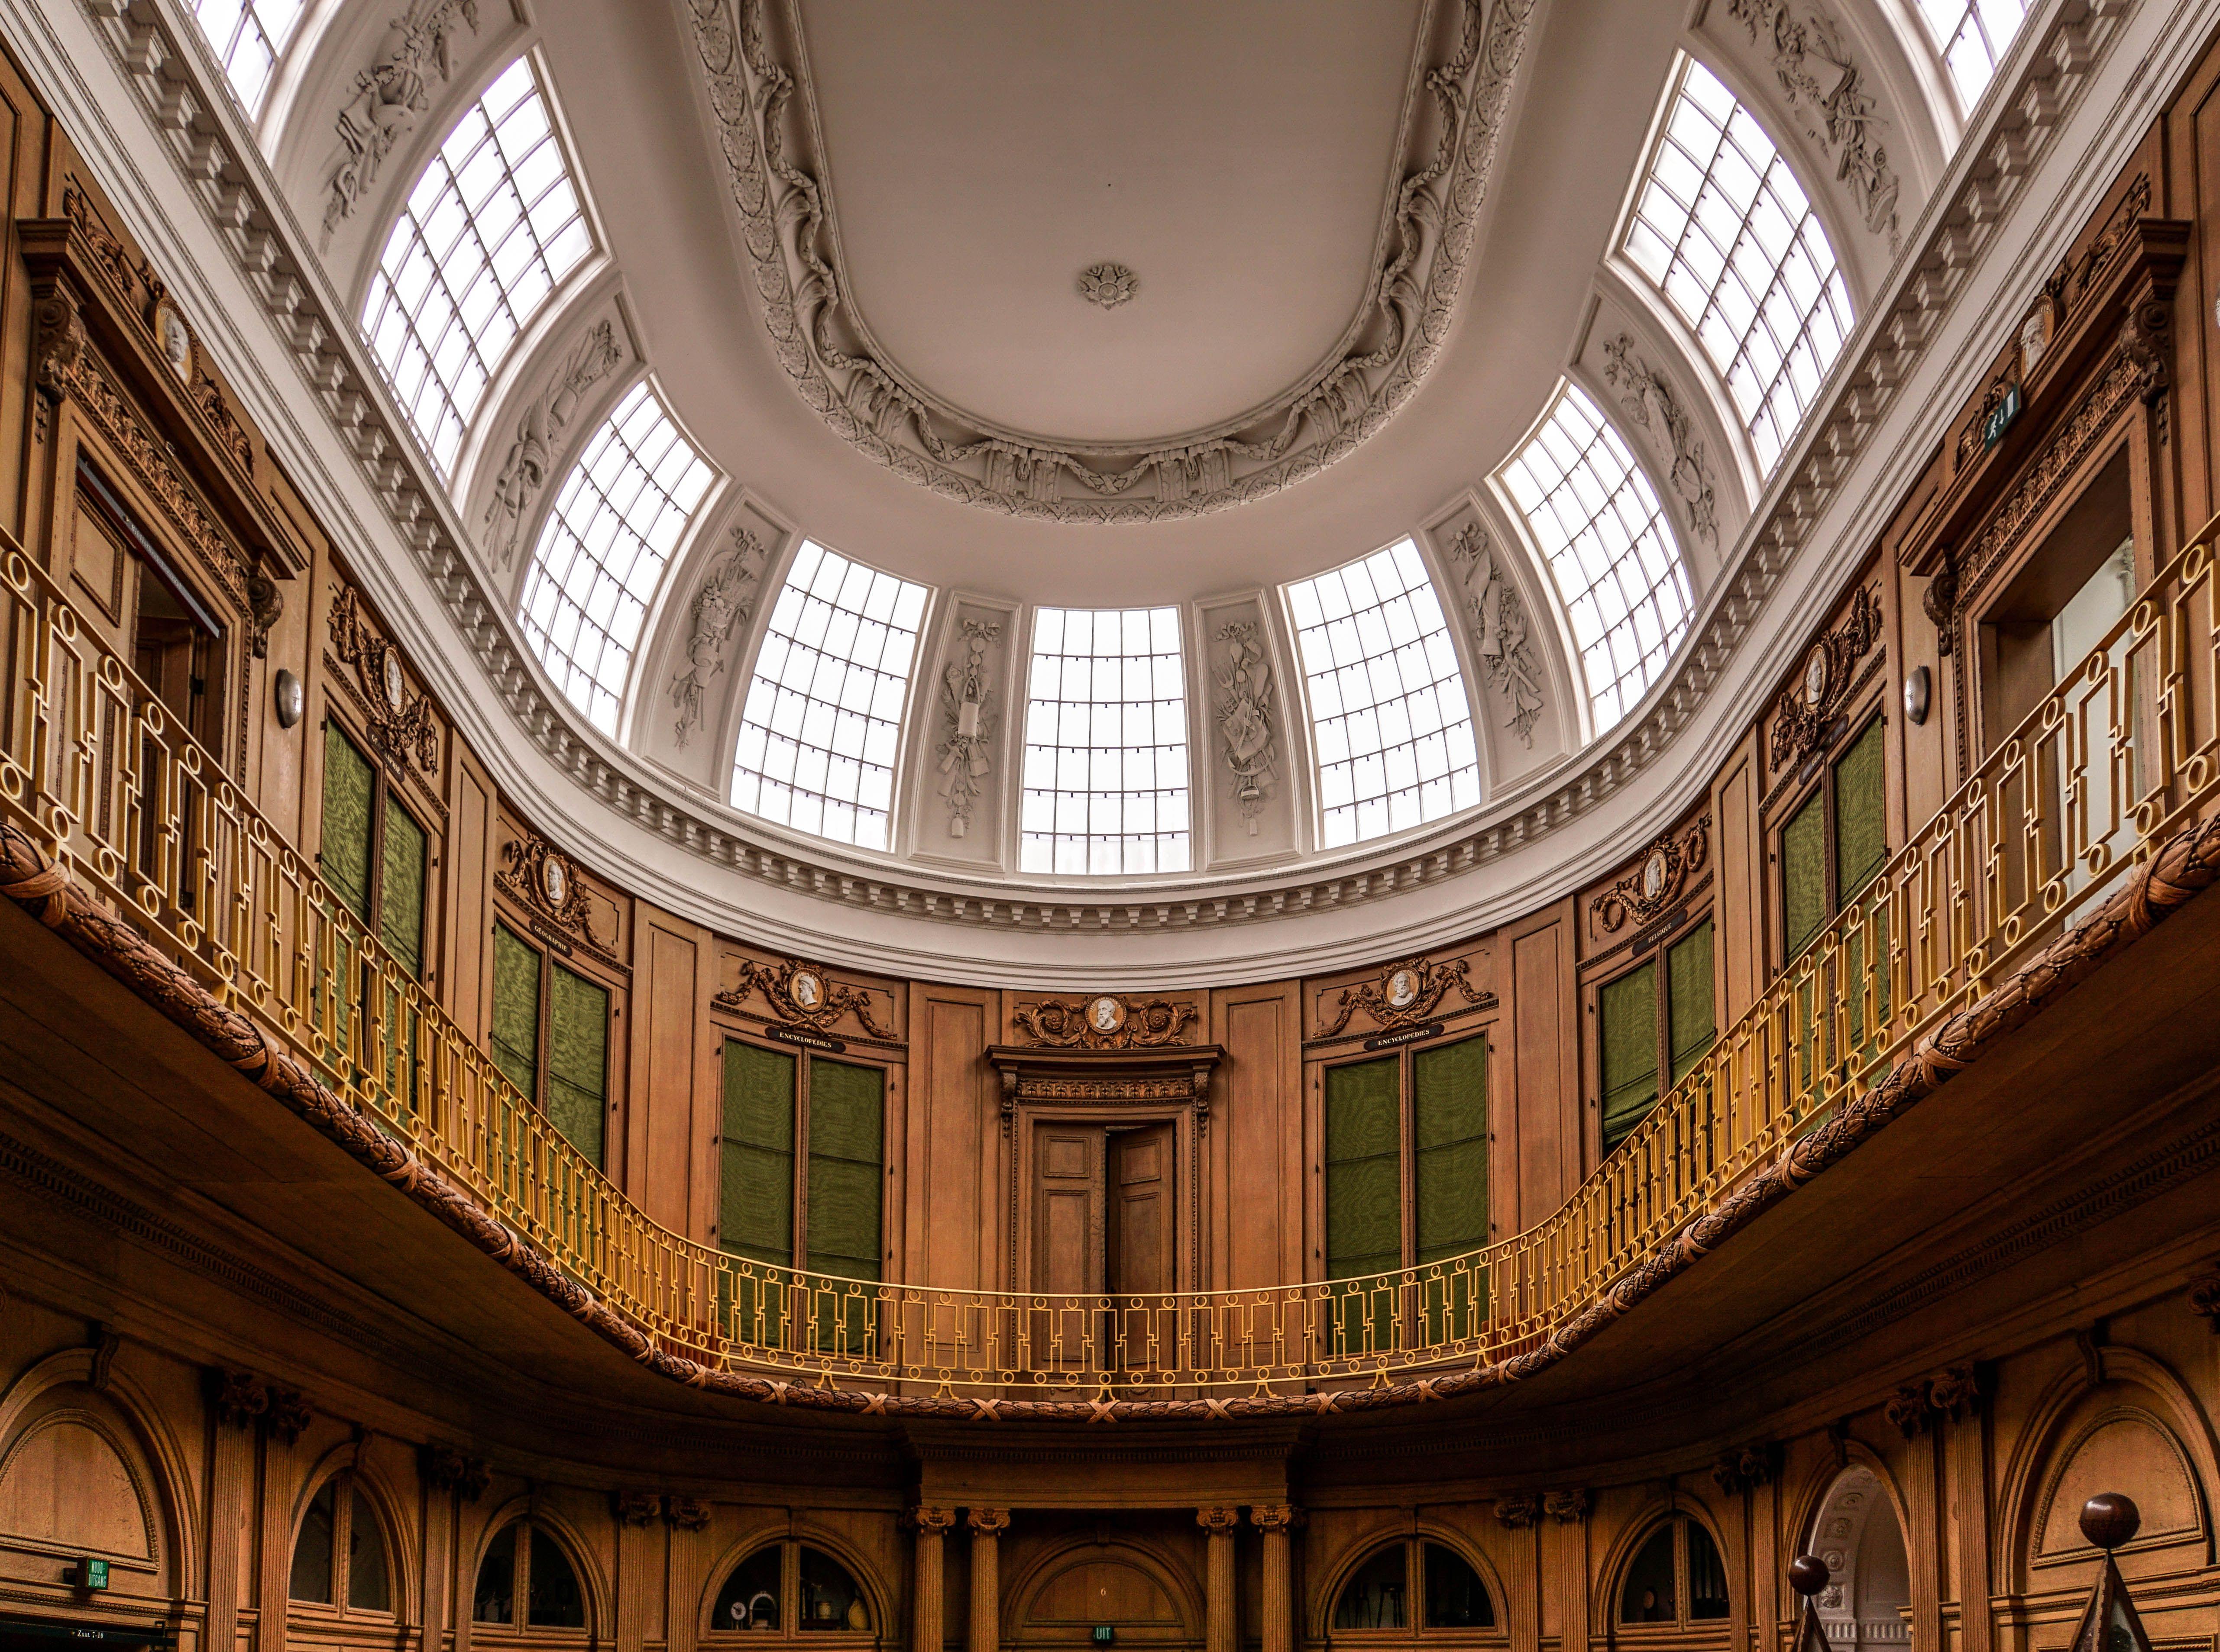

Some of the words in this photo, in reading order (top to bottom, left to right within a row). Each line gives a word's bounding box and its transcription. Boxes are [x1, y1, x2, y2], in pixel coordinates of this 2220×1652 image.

[1648, 922, 1672, 943] BELGIQUE
[1100, 1587, 1106, 1597] 6
[1096, 1627, 1110, 1639] UIT
